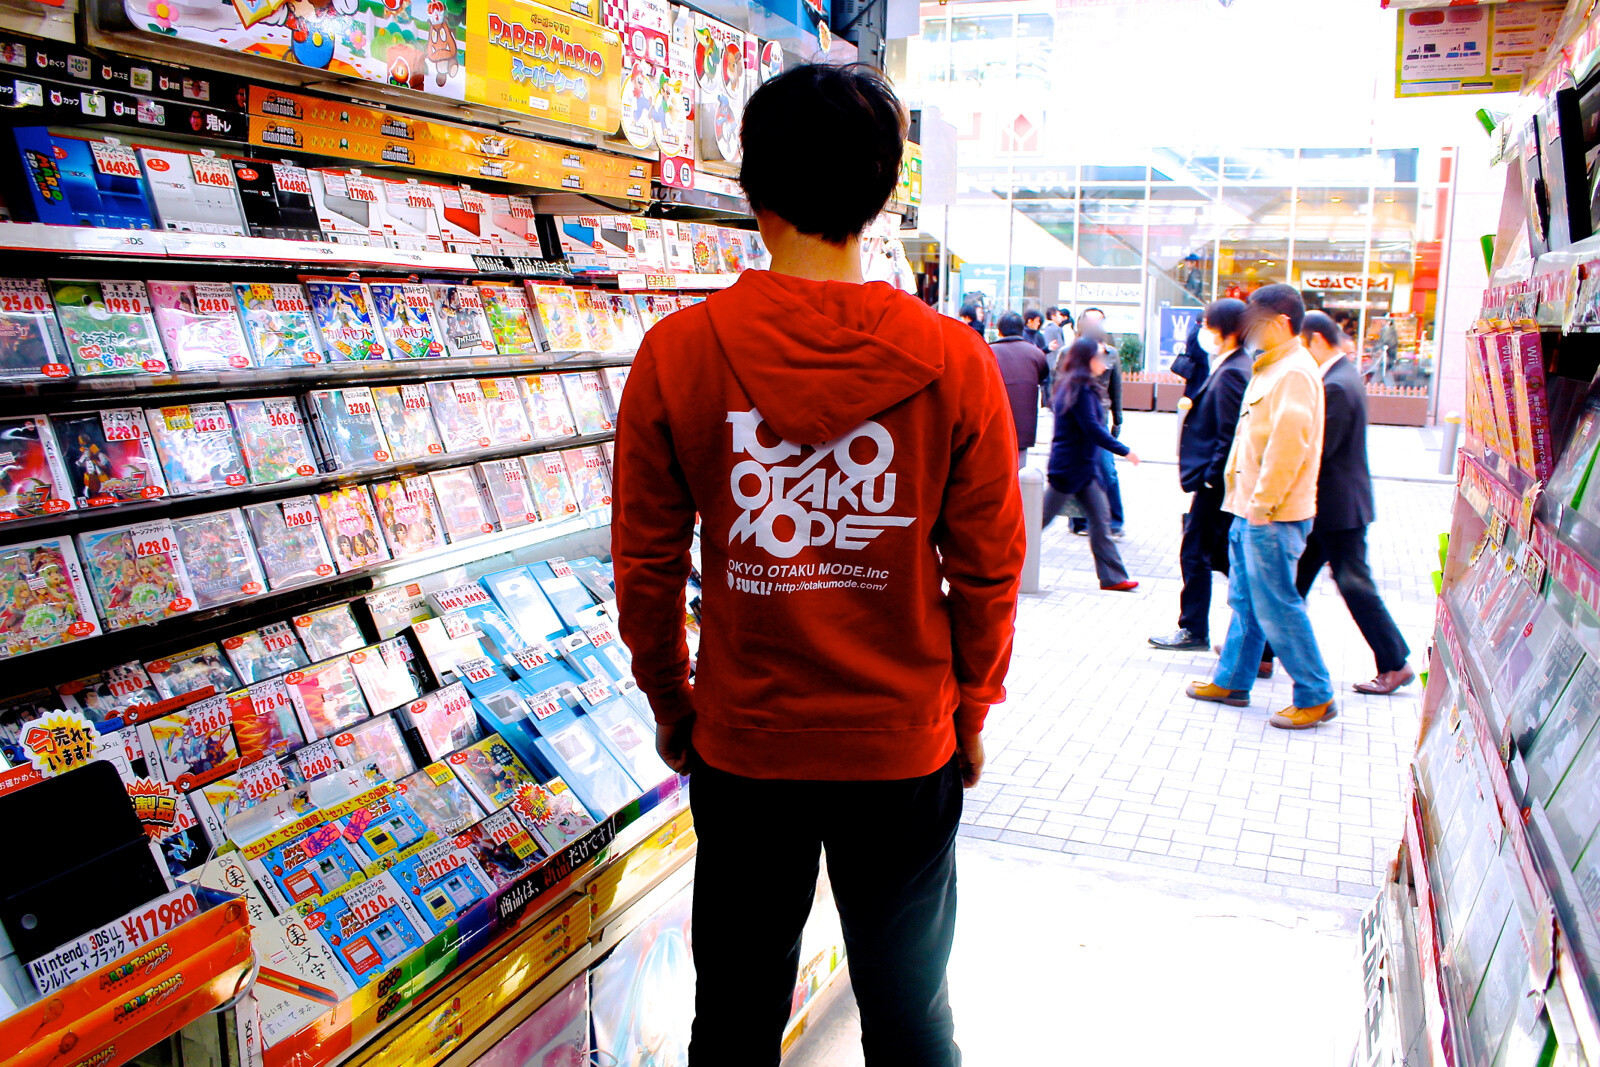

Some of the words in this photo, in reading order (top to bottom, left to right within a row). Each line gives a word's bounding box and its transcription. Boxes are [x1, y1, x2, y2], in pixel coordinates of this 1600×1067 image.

[488, 13, 549, 60] PAPER
[549, 35, 604, 77] MARIO
[511, 57, 588, 99] スーパーシール
[262, 101, 279, 113] MARIO
[277, 96, 294, 106] SUPER
[206, 113, 231, 133] 鬼トレ
[277, 126, 294, 135] SUPER
[262, 130, 279, 142] MARIO
[33, 167, 52, 199] LAND
[36, 153, 63, 202] MARIO
[172, 182, 186, 190] 3DS
[124, 236, 144, 246] 3DS
[319, 247, 334, 255] 3DS
[403, 286, 429, 295] カルドセプト
[106, 298, 150, 314] 1980円
[199, 298, 236, 313] 2480円
[81, 331, 117, 345] お茶犬
[326, 327, 373, 341] カルドセプト
[389, 326, 432, 341] カルドセプト
[102, 353, 143, 366] なかよし
[1526, 344, 1540, 366] Wii
[269, 412, 303, 427] 3680円
[106, 424, 150, 441] 2280円
[730, 459, 897, 514] OTAKU
[286, 510, 319, 528] 2680円
[728, 498, 918, 559] MODE
[137, 537, 178, 556] 4280円
[767, 564, 815, 578] OTAKU
[818, 563, 889, 580] MODE.Inc
[736, 577, 773, 596] SUKI!
[774, 579, 888, 595] http://otakumode.com/
[188, 697, 228, 716] ポケットモンスター
[255, 692, 291, 716] 1780円
[194, 711, 234, 736] 3680円
[239, 758, 277, 777] ポケットモンスター
[303, 754, 339, 780] 2480円
[249, 772, 287, 799] 3680円
[132, 795, 177, 825] 製品
[218, 857, 233, 868] DS
[428, 855, 467, 878] 1780円
[262, 874, 273, 890] DS
[354, 894, 397, 922] 1780円
[400, 896, 412, 911] DS
[121, 893, 199, 947] ¥17980
[277, 915, 294, 927] DS
[307, 914, 320, 924] 見本
[309, 918, 327, 930] SAMPLE
[33, 942, 90, 979] Nintendo
[89, 929, 110, 951] 3DS
[110, 926, 122, 941] LL
[144, 947, 173, 976] OPEN
[286, 923, 326, 981] 美文字
[39, 967, 79, 994] シルバー
[90, 940, 126, 968] ブラック
[99, 962, 135, 991] MARIO
[132, 942, 170, 970] TENNIS
[113, 992, 149, 1023] MARIO
[146, 972, 183, 1003] TENNIS
[156, 978, 186, 1006] OPEN
